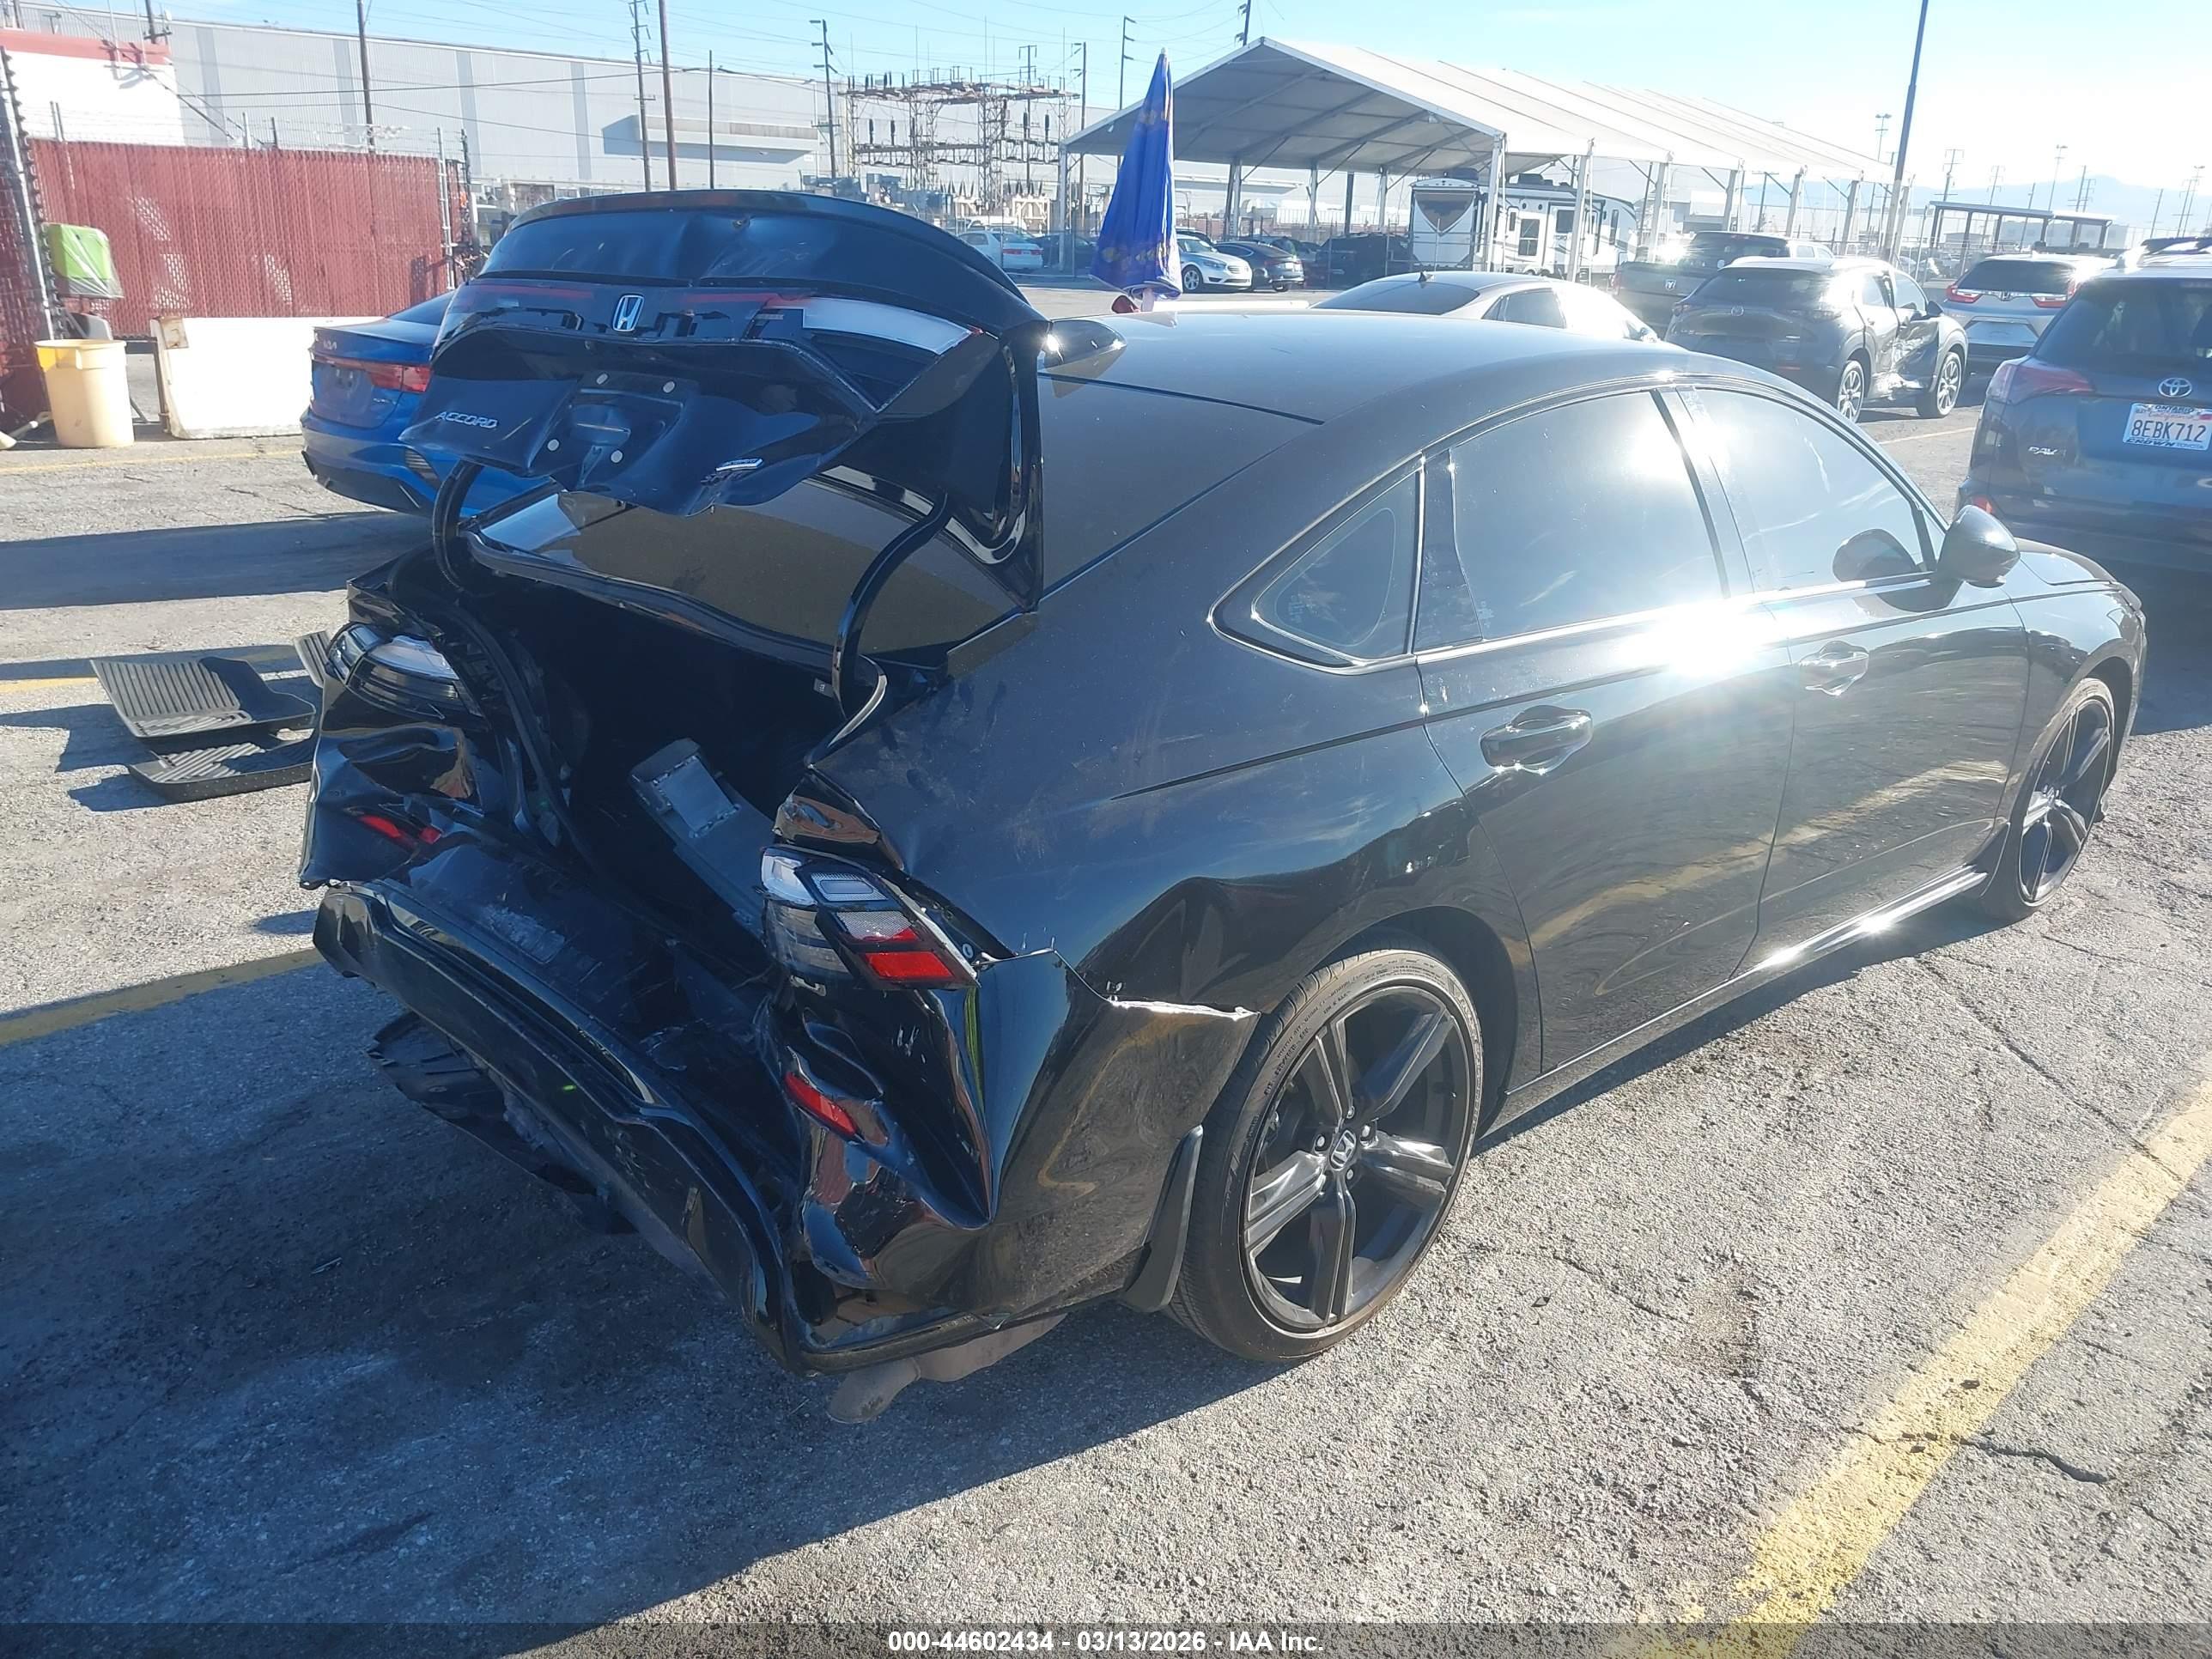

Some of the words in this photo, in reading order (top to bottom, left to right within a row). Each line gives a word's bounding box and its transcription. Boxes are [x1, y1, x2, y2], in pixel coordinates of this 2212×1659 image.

[434, 411, 498, 428] ACCORD
[2131, 419, 2207, 443] 8EBK712
[2126, 438, 2175, 447] CROWN
